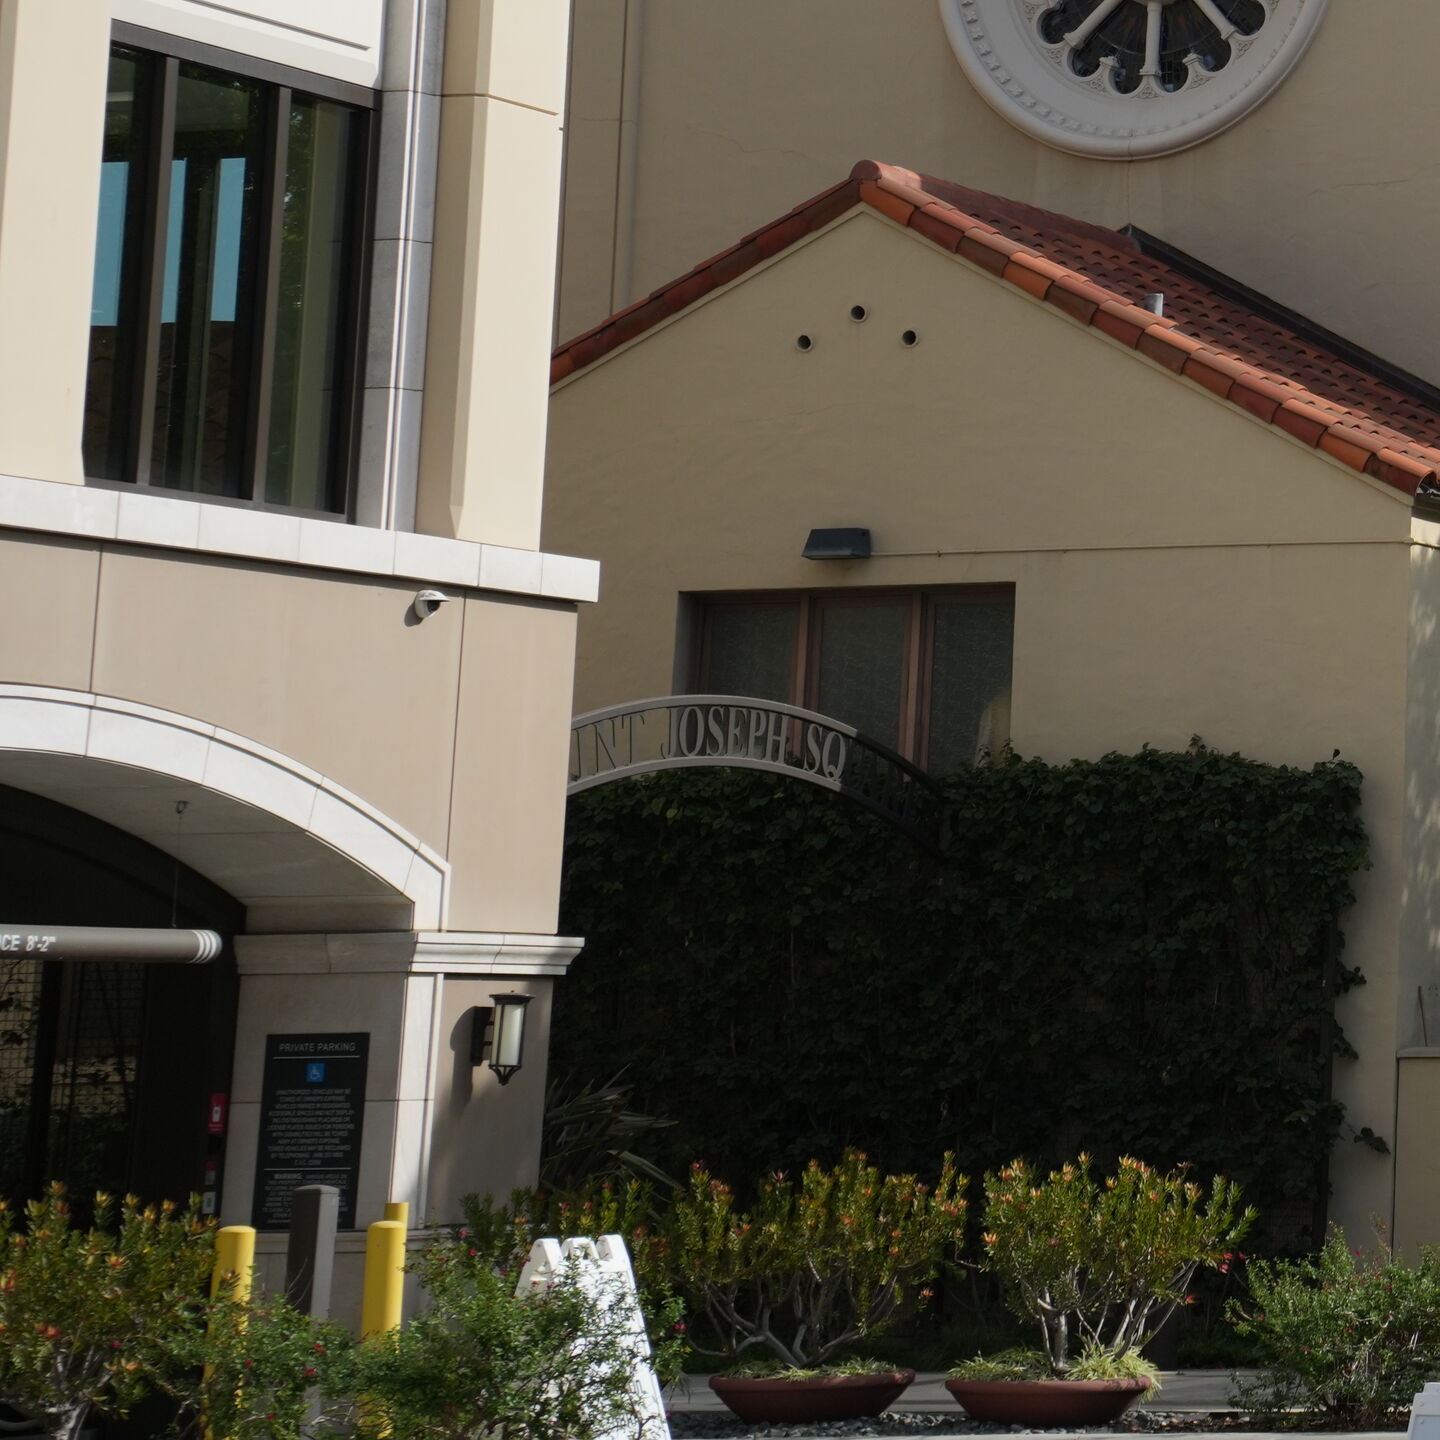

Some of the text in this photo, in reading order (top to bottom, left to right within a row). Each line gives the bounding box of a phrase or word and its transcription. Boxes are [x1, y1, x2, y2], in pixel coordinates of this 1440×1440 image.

[660, 706, 790, 765] JOSEPH
[279, 1042, 356, 1052] PRIVATE PARKING
